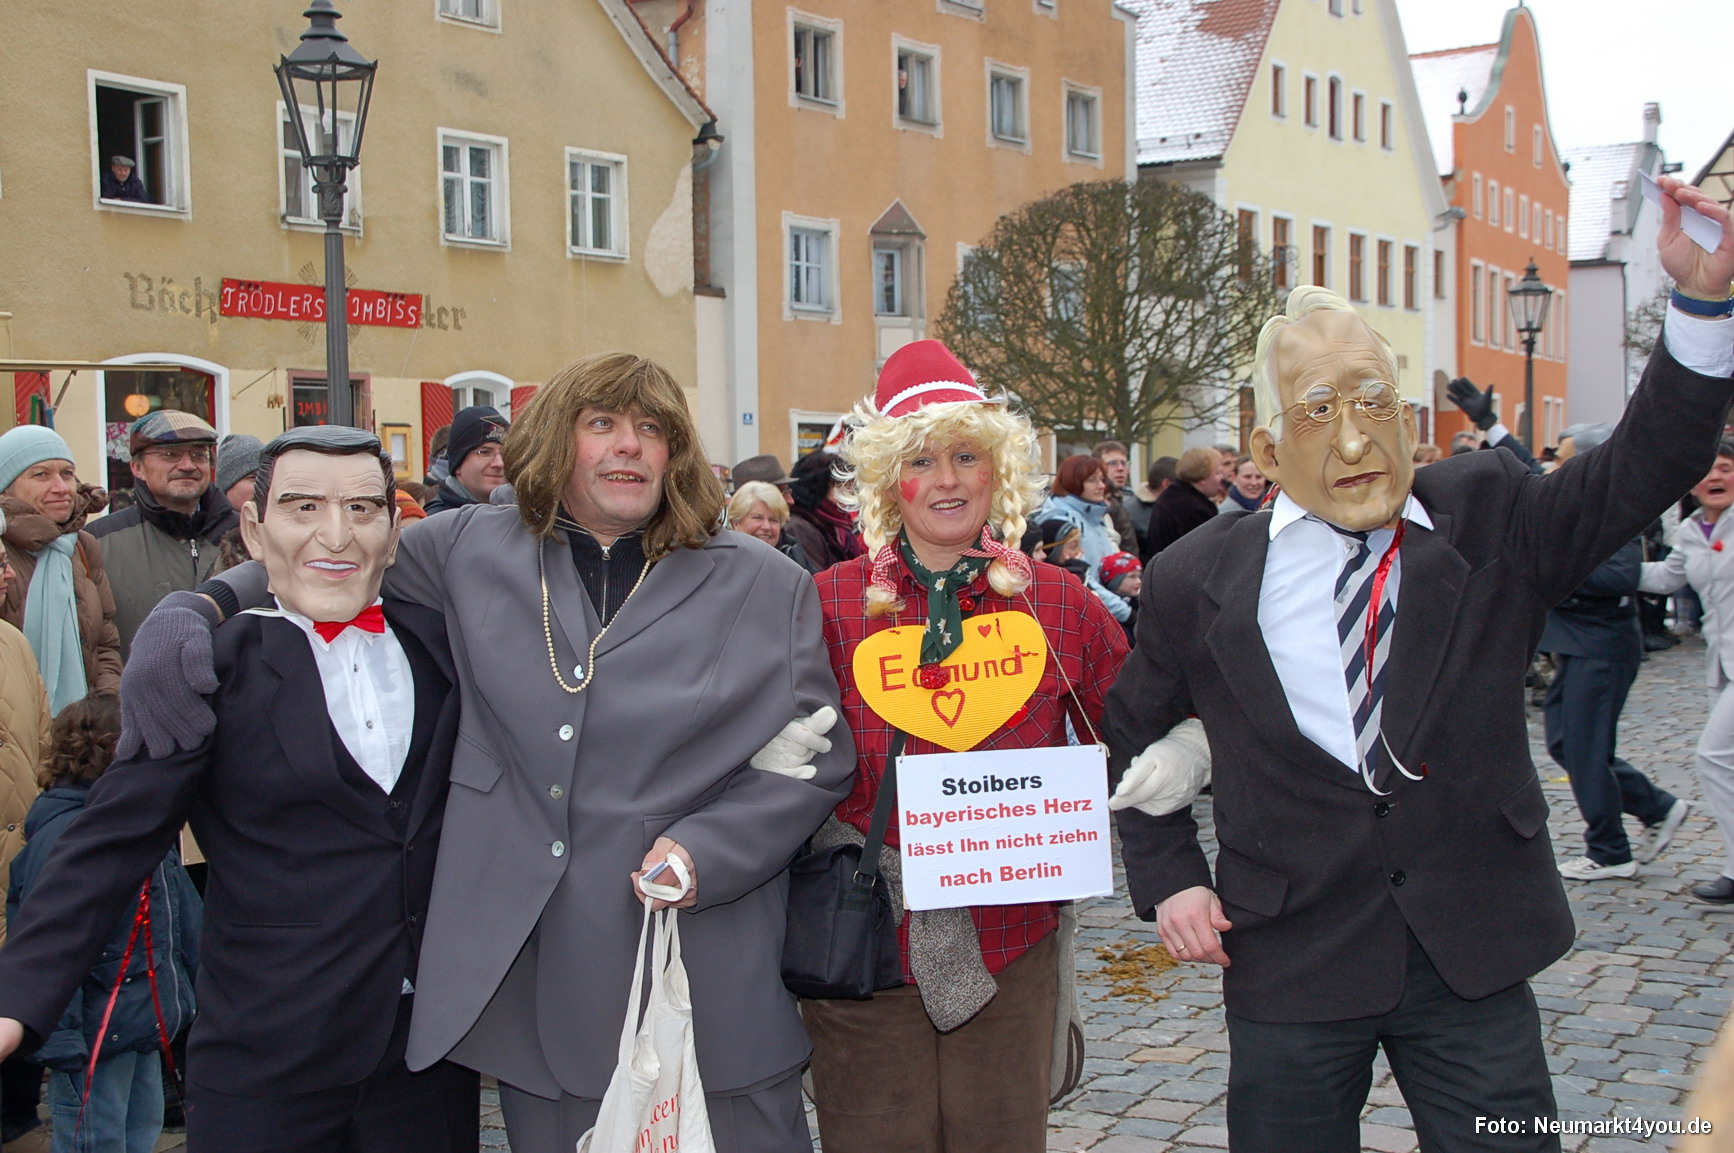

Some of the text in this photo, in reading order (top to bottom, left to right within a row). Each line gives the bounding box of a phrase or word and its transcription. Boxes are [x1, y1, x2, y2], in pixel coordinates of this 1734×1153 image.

[424, 295, 467, 331] ter
[297, 400, 327, 416] IMBI
[106, 421, 128, 440] ER
[942, 775, 1043, 796] Stoibers
[905, 798, 1093, 828] bayerisches Herz
[907, 829, 1098, 857] lässt Ihn nicht ziehn
[939, 862, 1063, 888] nach Berlin
